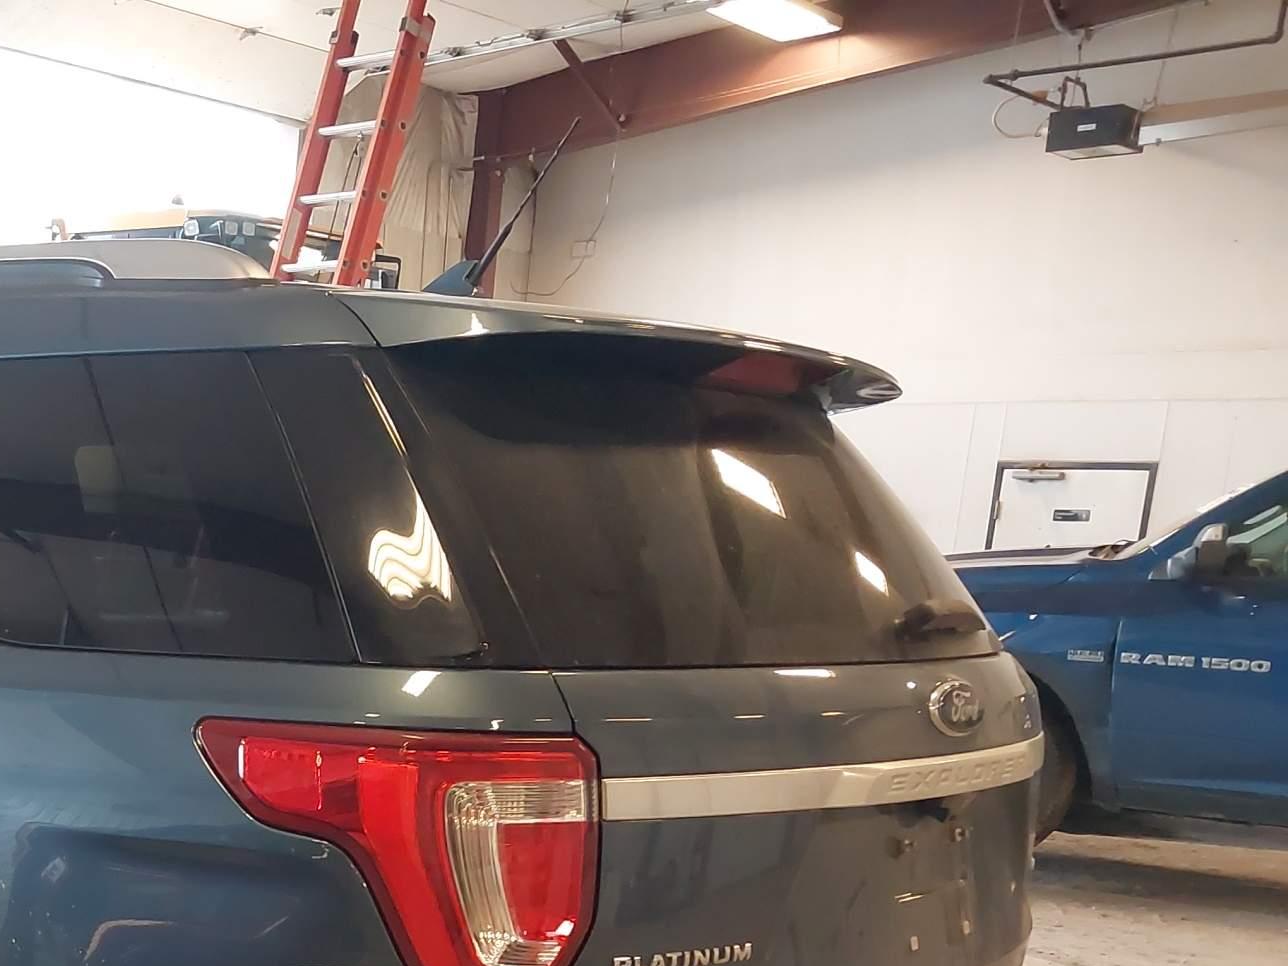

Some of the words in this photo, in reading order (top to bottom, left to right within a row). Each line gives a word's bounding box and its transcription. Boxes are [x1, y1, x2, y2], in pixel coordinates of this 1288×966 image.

[1120, 652, 1195, 667] RAM
[1201, 658, 1271, 673] 1500
[888, 752, 1027, 795] EXPLORER
